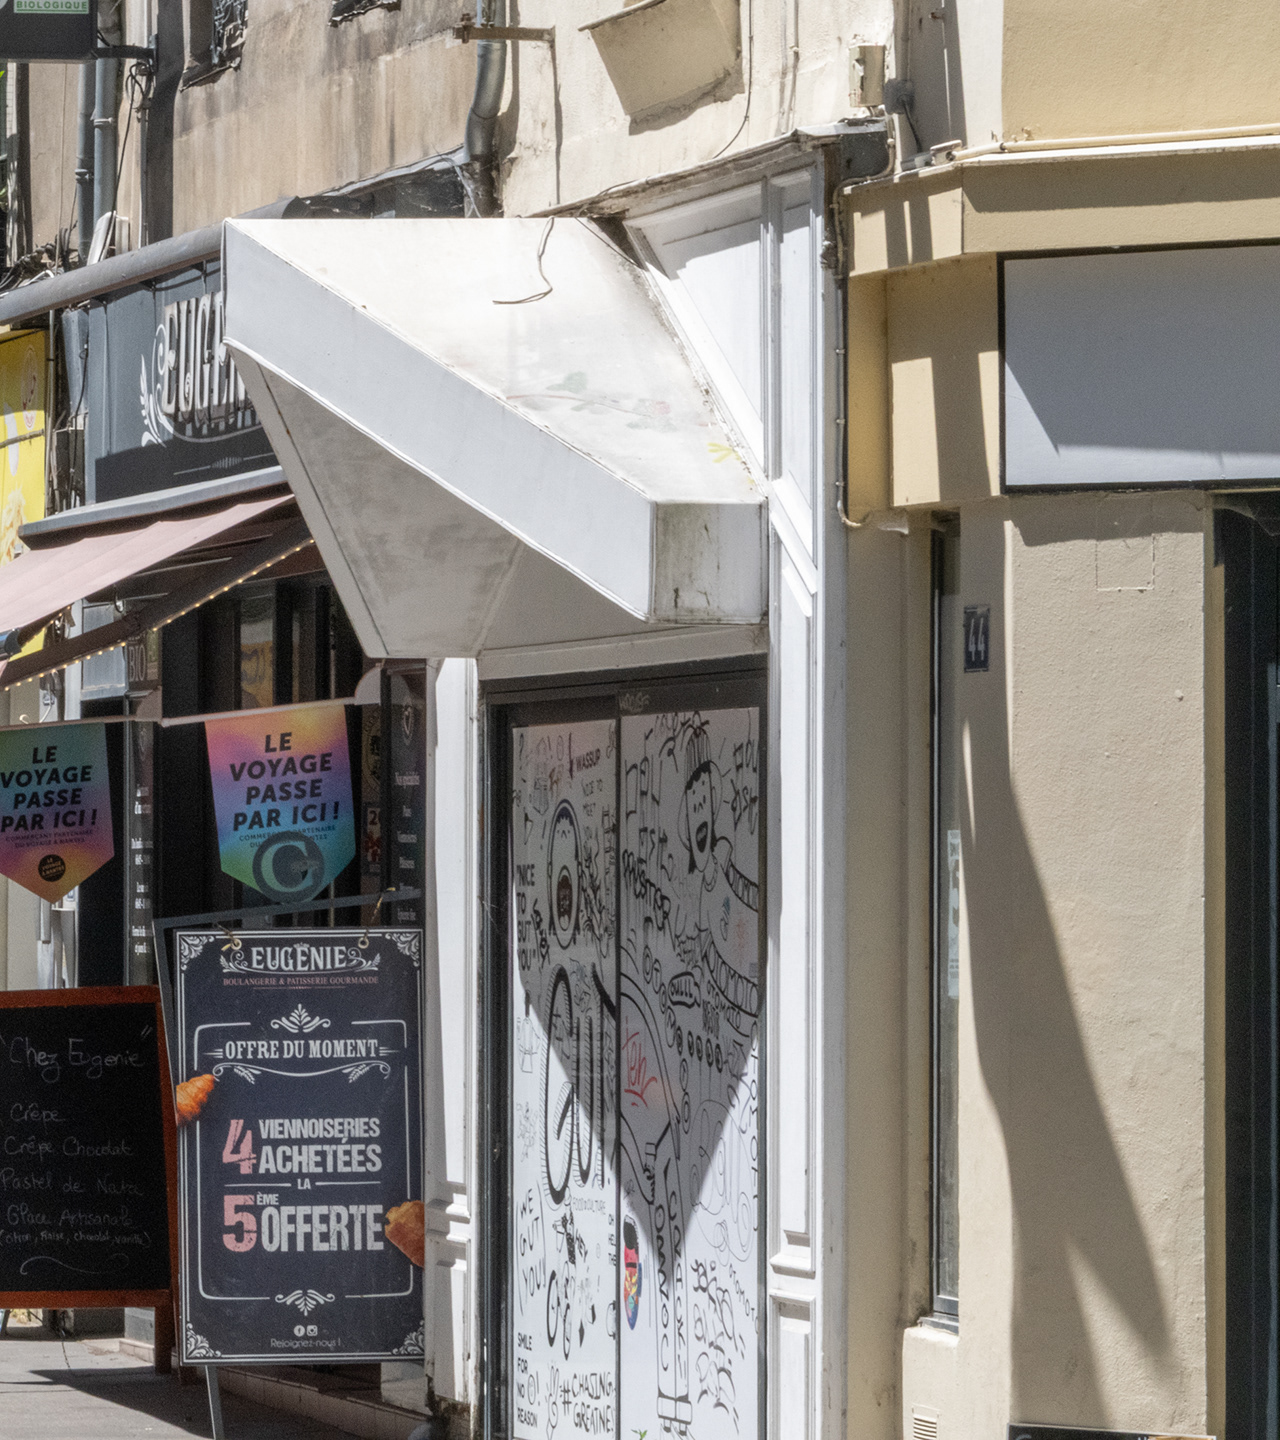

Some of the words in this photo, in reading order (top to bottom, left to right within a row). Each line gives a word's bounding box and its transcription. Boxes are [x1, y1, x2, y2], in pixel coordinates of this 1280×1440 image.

[16, 1, 87, 9] BIOLOGIQUE
[968, 617, 985, 662] 44
[128, 644, 146, 682] BIO
[265, 732, 292, 753] LE
[32, 746, 57, 764] LE
[229, 752, 333, 781] VOYAGE
[575, 748, 601, 772] WASSUP
[0, 765, 94, 789] VOYAGE
[13, 788, 83, 809] PASSE
[246, 779, 323, 805] PASSE
[0, 814, 44, 833] PAR
[53, 809, 85, 828] ICI
[233, 808, 281, 831] PAR
[292, 803, 326, 825] ICI
[517, 892, 527, 914] TO
[223, 978, 277, 987] BOULANGERIE
[278, 977, 285, 985] &
[286, 977, 328, 985] PATISSERIE
[330, 976, 380, 985] GOURMANDE
[9, 1036, 62, 1084] Chez
[225, 1041, 280, 1059] OFFRE
[282, 1040, 305, 1059] DU
[308, 1039, 379, 1058] MOMENT
[10, 1102, 63, 1134] Crêpe
[4, 1135, 54, 1162] Crêpe
[222, 1119, 257, 1174] 4
[258, 1117, 381, 1139] VIENNOISERIES
[258, 1138, 382, 1174] ACHETÉES
[0, 1167, 54, 1191] Pastel
[62, 1175, 85, 1193] de
[297, 1178, 312, 1190] LA
[222, 1194, 257, 1253] 5
[256, 1191, 279, 1205] ÈME
[261, 1205, 385, 1252] OFFERTE
[517, 1332, 533, 1351] SMILE
[517, 1357, 528, 1374] FOR
[517, 1407, 538, 1429] REASON
